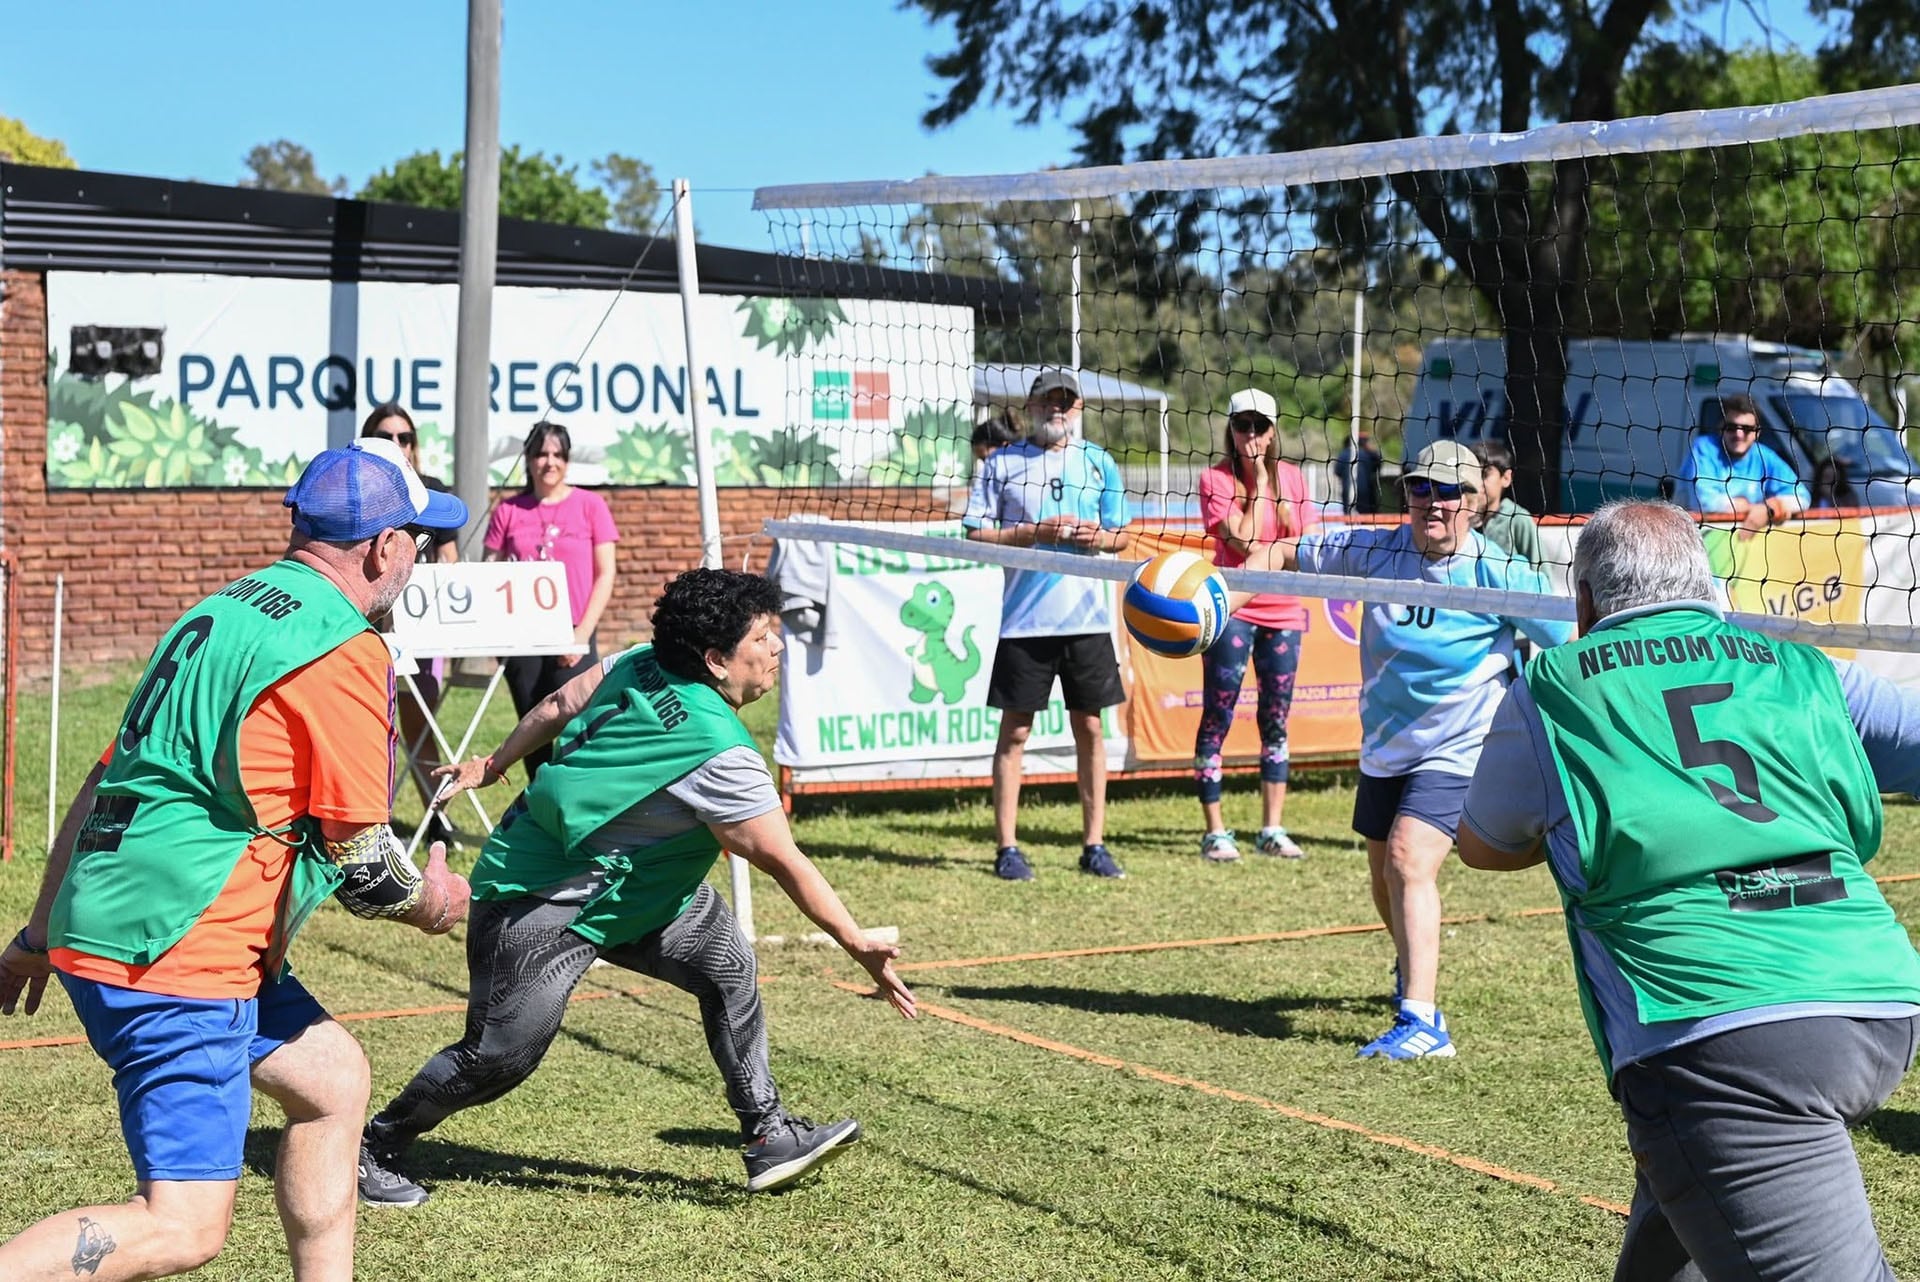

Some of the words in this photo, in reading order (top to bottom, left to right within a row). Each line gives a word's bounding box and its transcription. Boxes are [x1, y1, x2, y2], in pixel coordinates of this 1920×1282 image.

[179, 354, 442, 411] PARQUE
[1051, 478, 1063, 502] 8
[250, 586, 302, 621] VGG
[1578, 634, 1715, 680] NEWCOM
[1716, 634, 1777, 666] VGG
[122, 614, 214, 752] 6
[652, 689, 689, 733] VGG
[818, 709, 937, 752] NEWCOM
[947, 699, 1064, 745] ROSIO
[1661, 682, 1780, 823] 5
[351, 868, 390, 896] PROCER
[1740, 888, 1780, 900] CIUDAD
